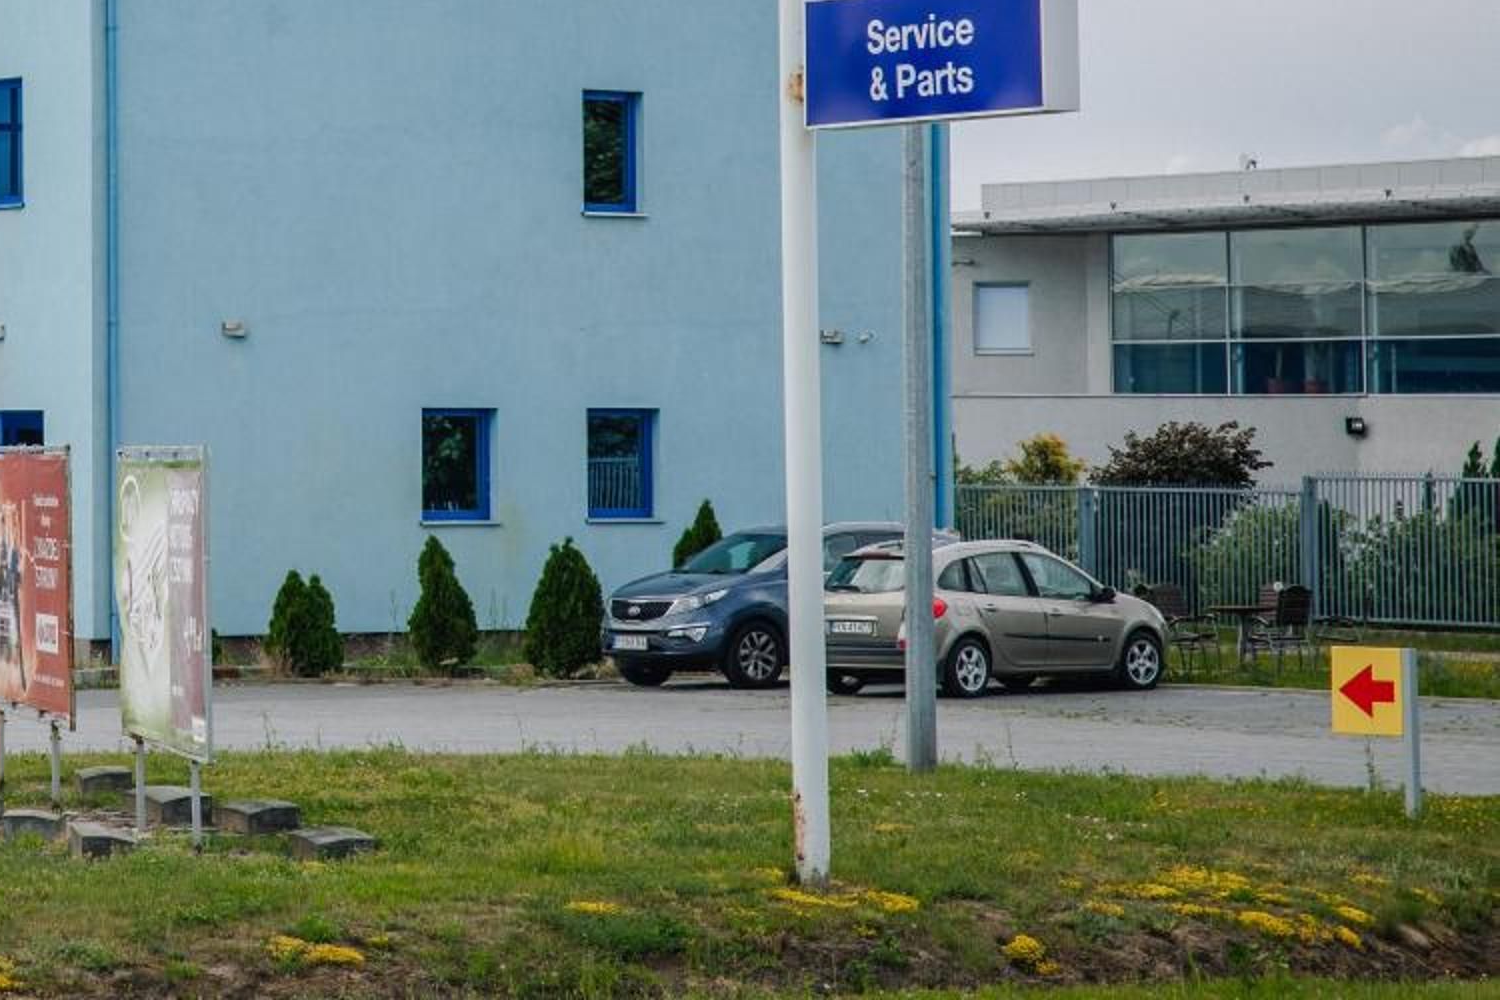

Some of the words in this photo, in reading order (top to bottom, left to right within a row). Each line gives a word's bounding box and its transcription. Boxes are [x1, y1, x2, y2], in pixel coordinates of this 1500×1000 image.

[867, 13, 975, 54] Service
[869, 66, 888, 101] &
[895, 61, 974, 99] Parts
